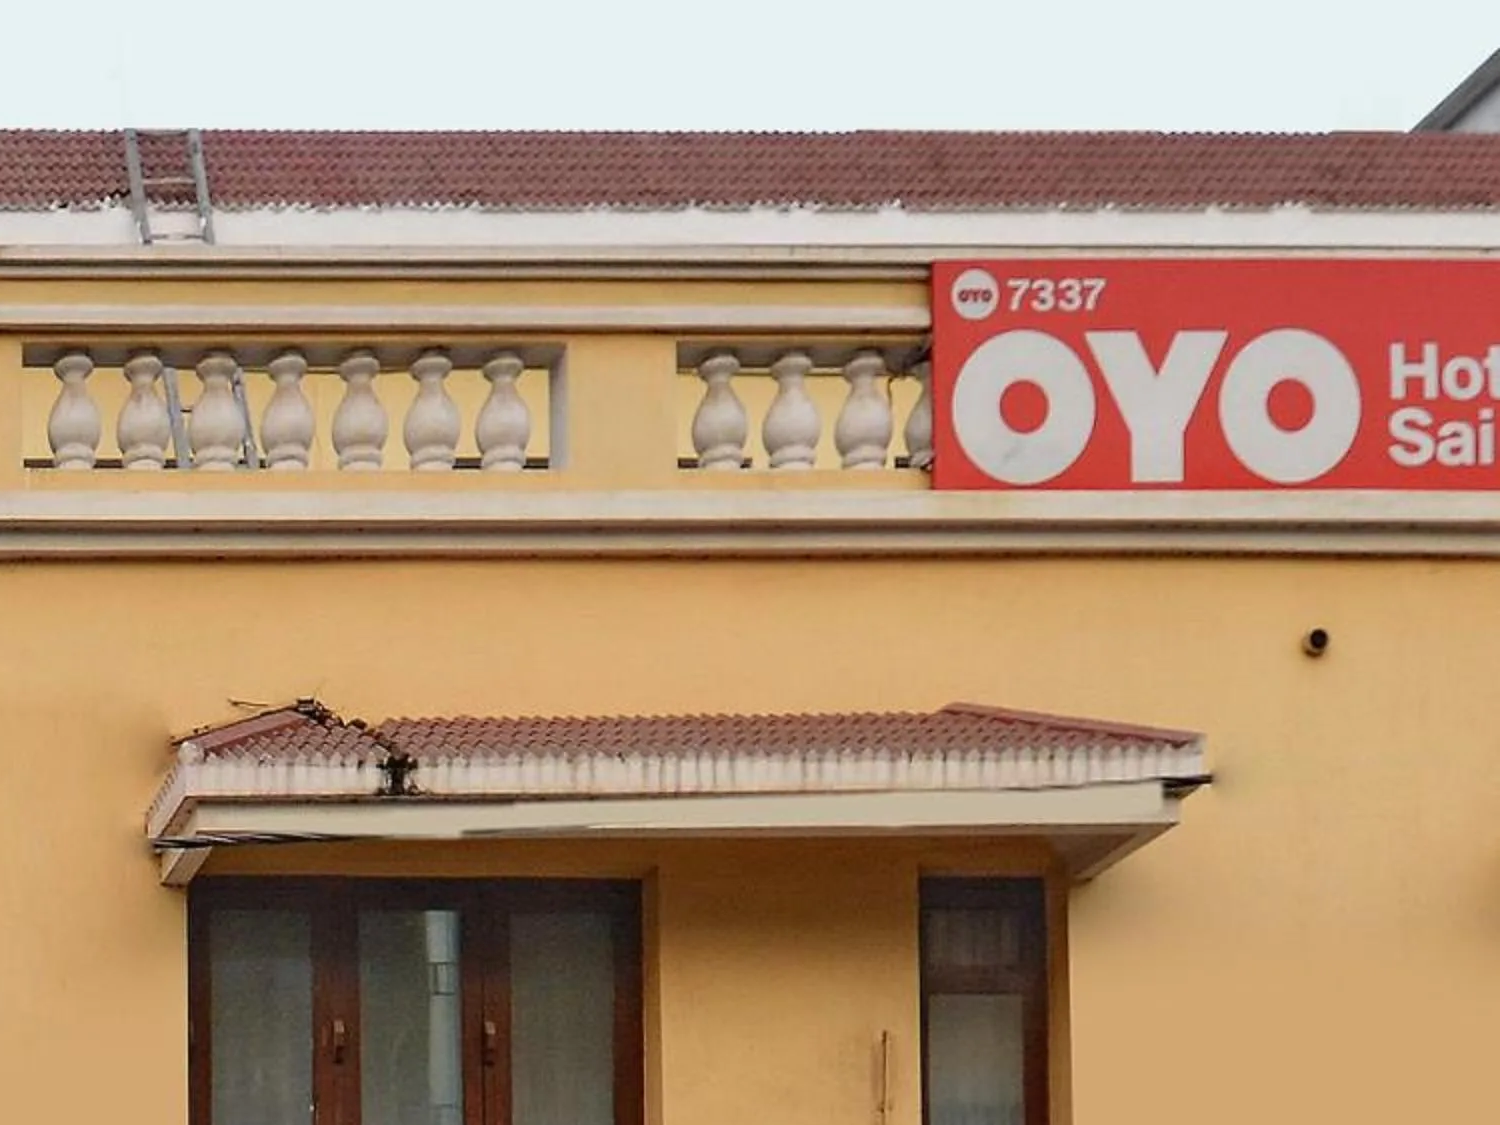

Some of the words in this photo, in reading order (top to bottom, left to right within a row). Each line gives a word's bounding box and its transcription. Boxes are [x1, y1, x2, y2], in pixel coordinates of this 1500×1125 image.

[958, 289, 993, 303] OYO
[1006, 277, 1107, 312] 7337
[952, 328, 1361, 485] OYO
[1387, 406, 1495, 467] Sai
